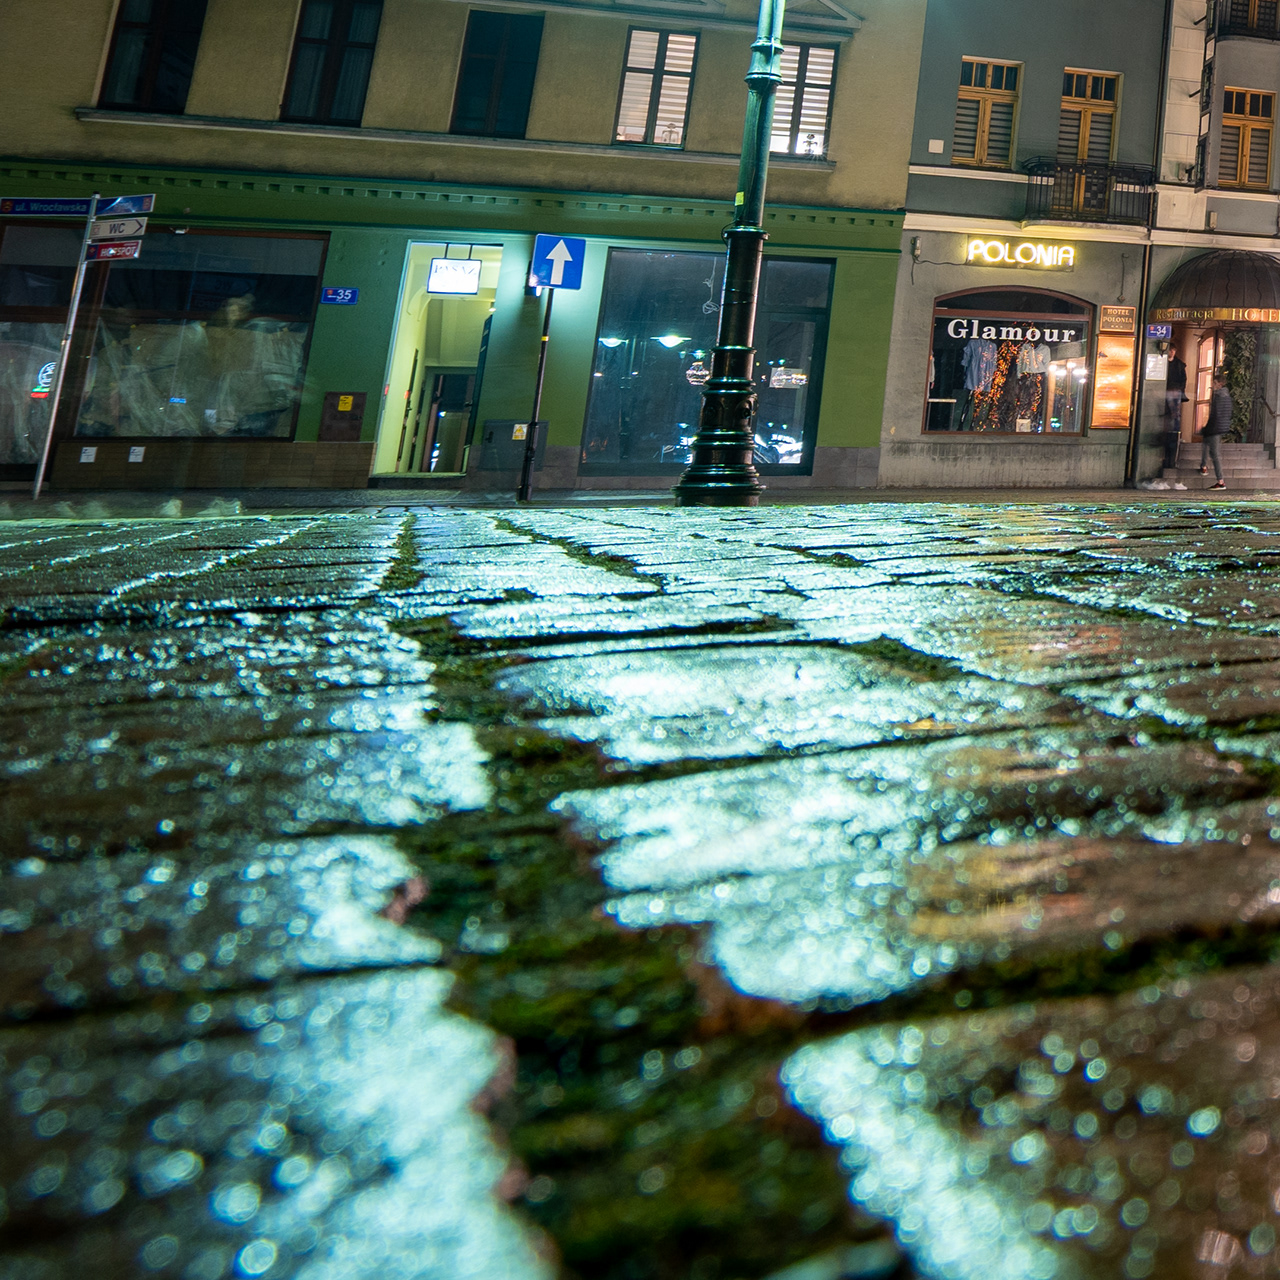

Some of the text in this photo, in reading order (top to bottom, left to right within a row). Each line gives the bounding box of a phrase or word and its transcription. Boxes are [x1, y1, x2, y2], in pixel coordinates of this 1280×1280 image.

[15, 202, 87, 212] ul. Wrocławska
[109, 222, 126, 234] WC
[968, 239, 1076, 267] POLONIA
[336, 289, 352, 300] 35
[1107, 308, 1130, 316] HOTEL
[1156, 308, 1214, 321] Restauracja
[1103, 316, 1133, 324] POLONIA
[947, 319, 1076, 343] Glamour
[1156, 325, 1167, 336] 34
